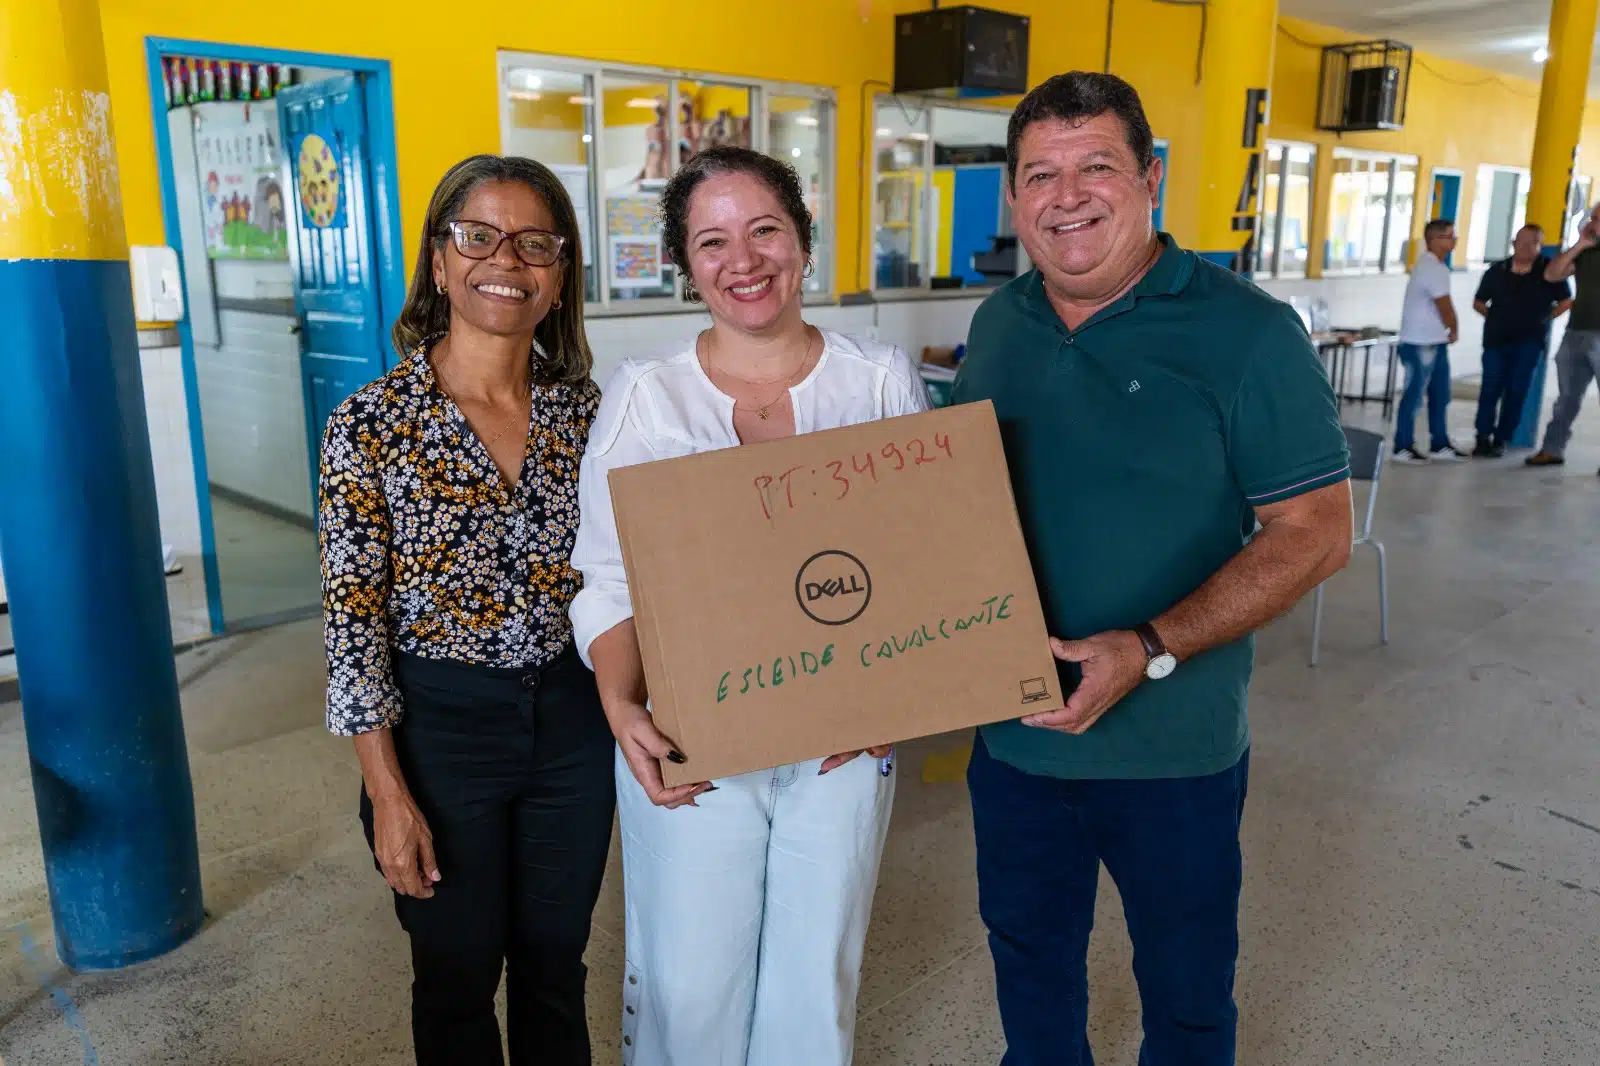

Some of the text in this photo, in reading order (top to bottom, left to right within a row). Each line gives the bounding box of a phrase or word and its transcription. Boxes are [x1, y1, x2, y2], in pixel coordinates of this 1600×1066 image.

[804, 575, 864, 601] DELL
[716, 593, 1014, 703] ESLEIDE CAVALCANTE
